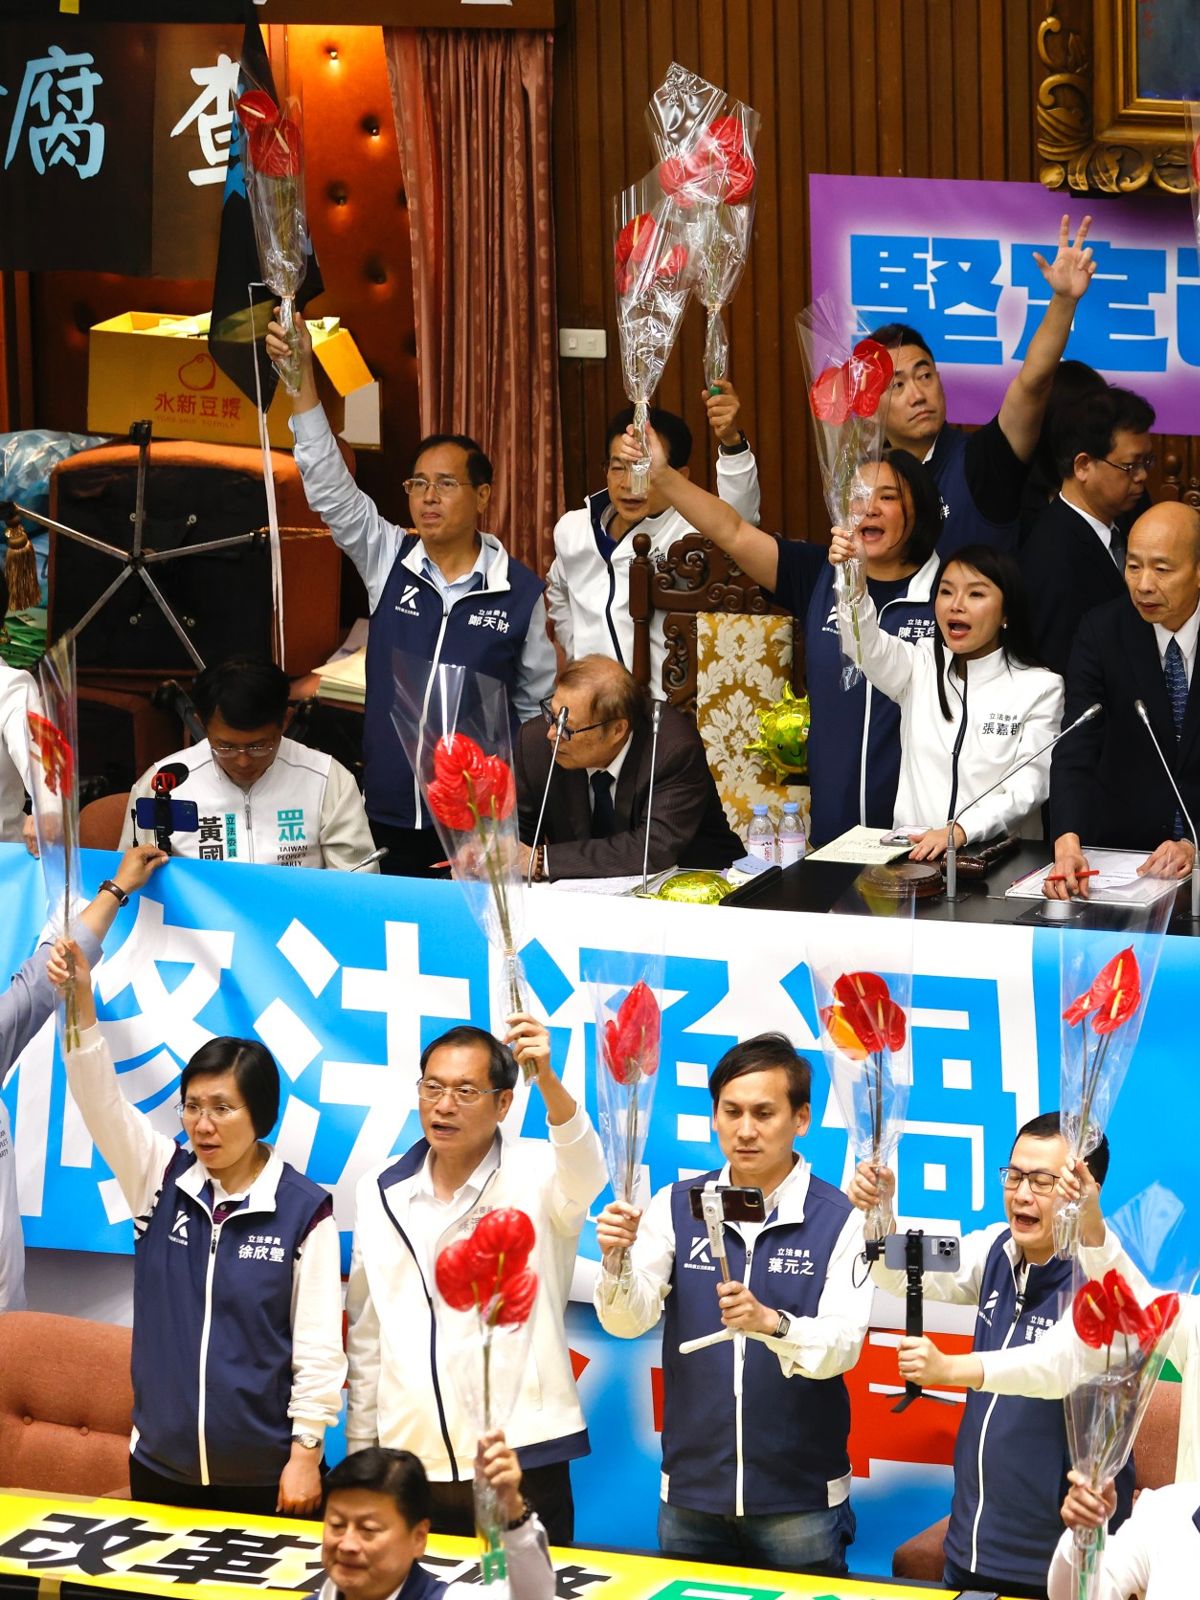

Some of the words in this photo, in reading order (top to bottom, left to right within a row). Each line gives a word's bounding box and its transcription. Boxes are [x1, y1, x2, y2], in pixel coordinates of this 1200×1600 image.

[154, 391, 242, 420] 永新豆漿
[279, 845, 308, 853] TAIWAN
[238, 1244, 285, 1263] 徐欣瑩
[777, 1247, 811, 1258] 立法委員
[767, 1257, 815, 1276] 葉元之
